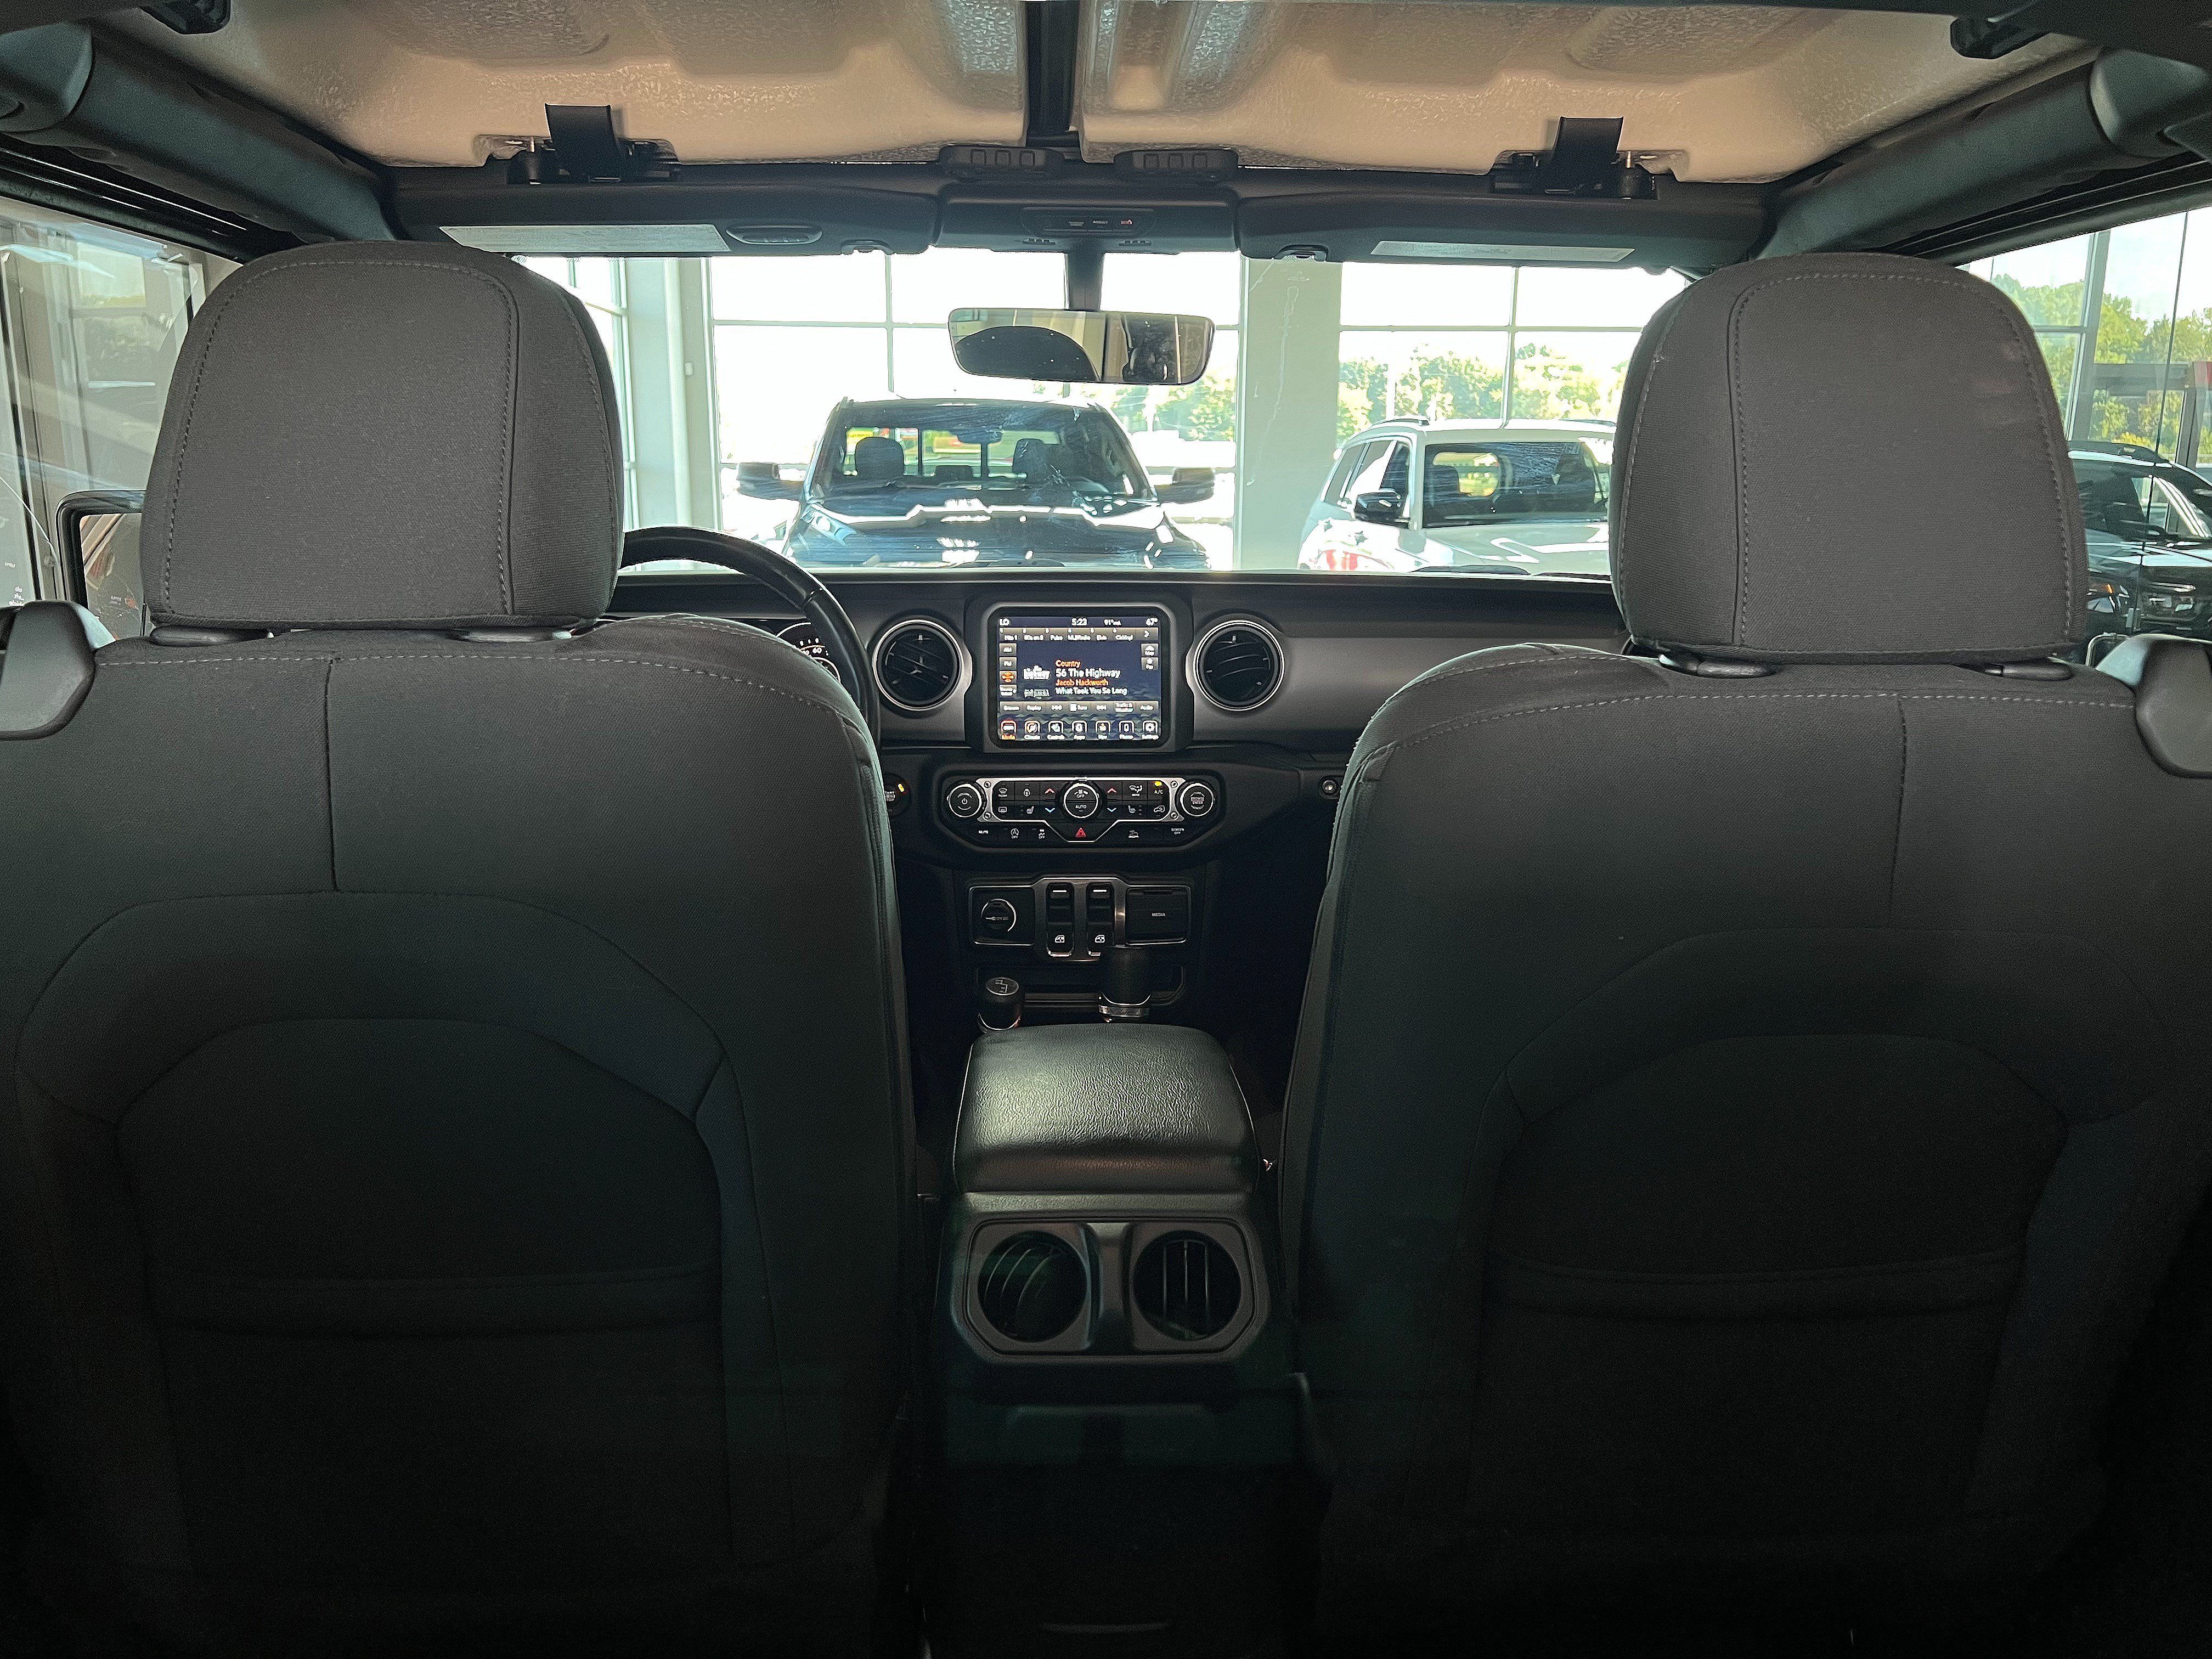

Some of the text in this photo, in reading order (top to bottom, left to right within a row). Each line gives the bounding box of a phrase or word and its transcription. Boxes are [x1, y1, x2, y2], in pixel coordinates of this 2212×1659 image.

[1055, 659, 1081, 668] Country
[1056, 667, 1121, 679] 56 The Highway
[1111, 687, 1128, 696] Long
